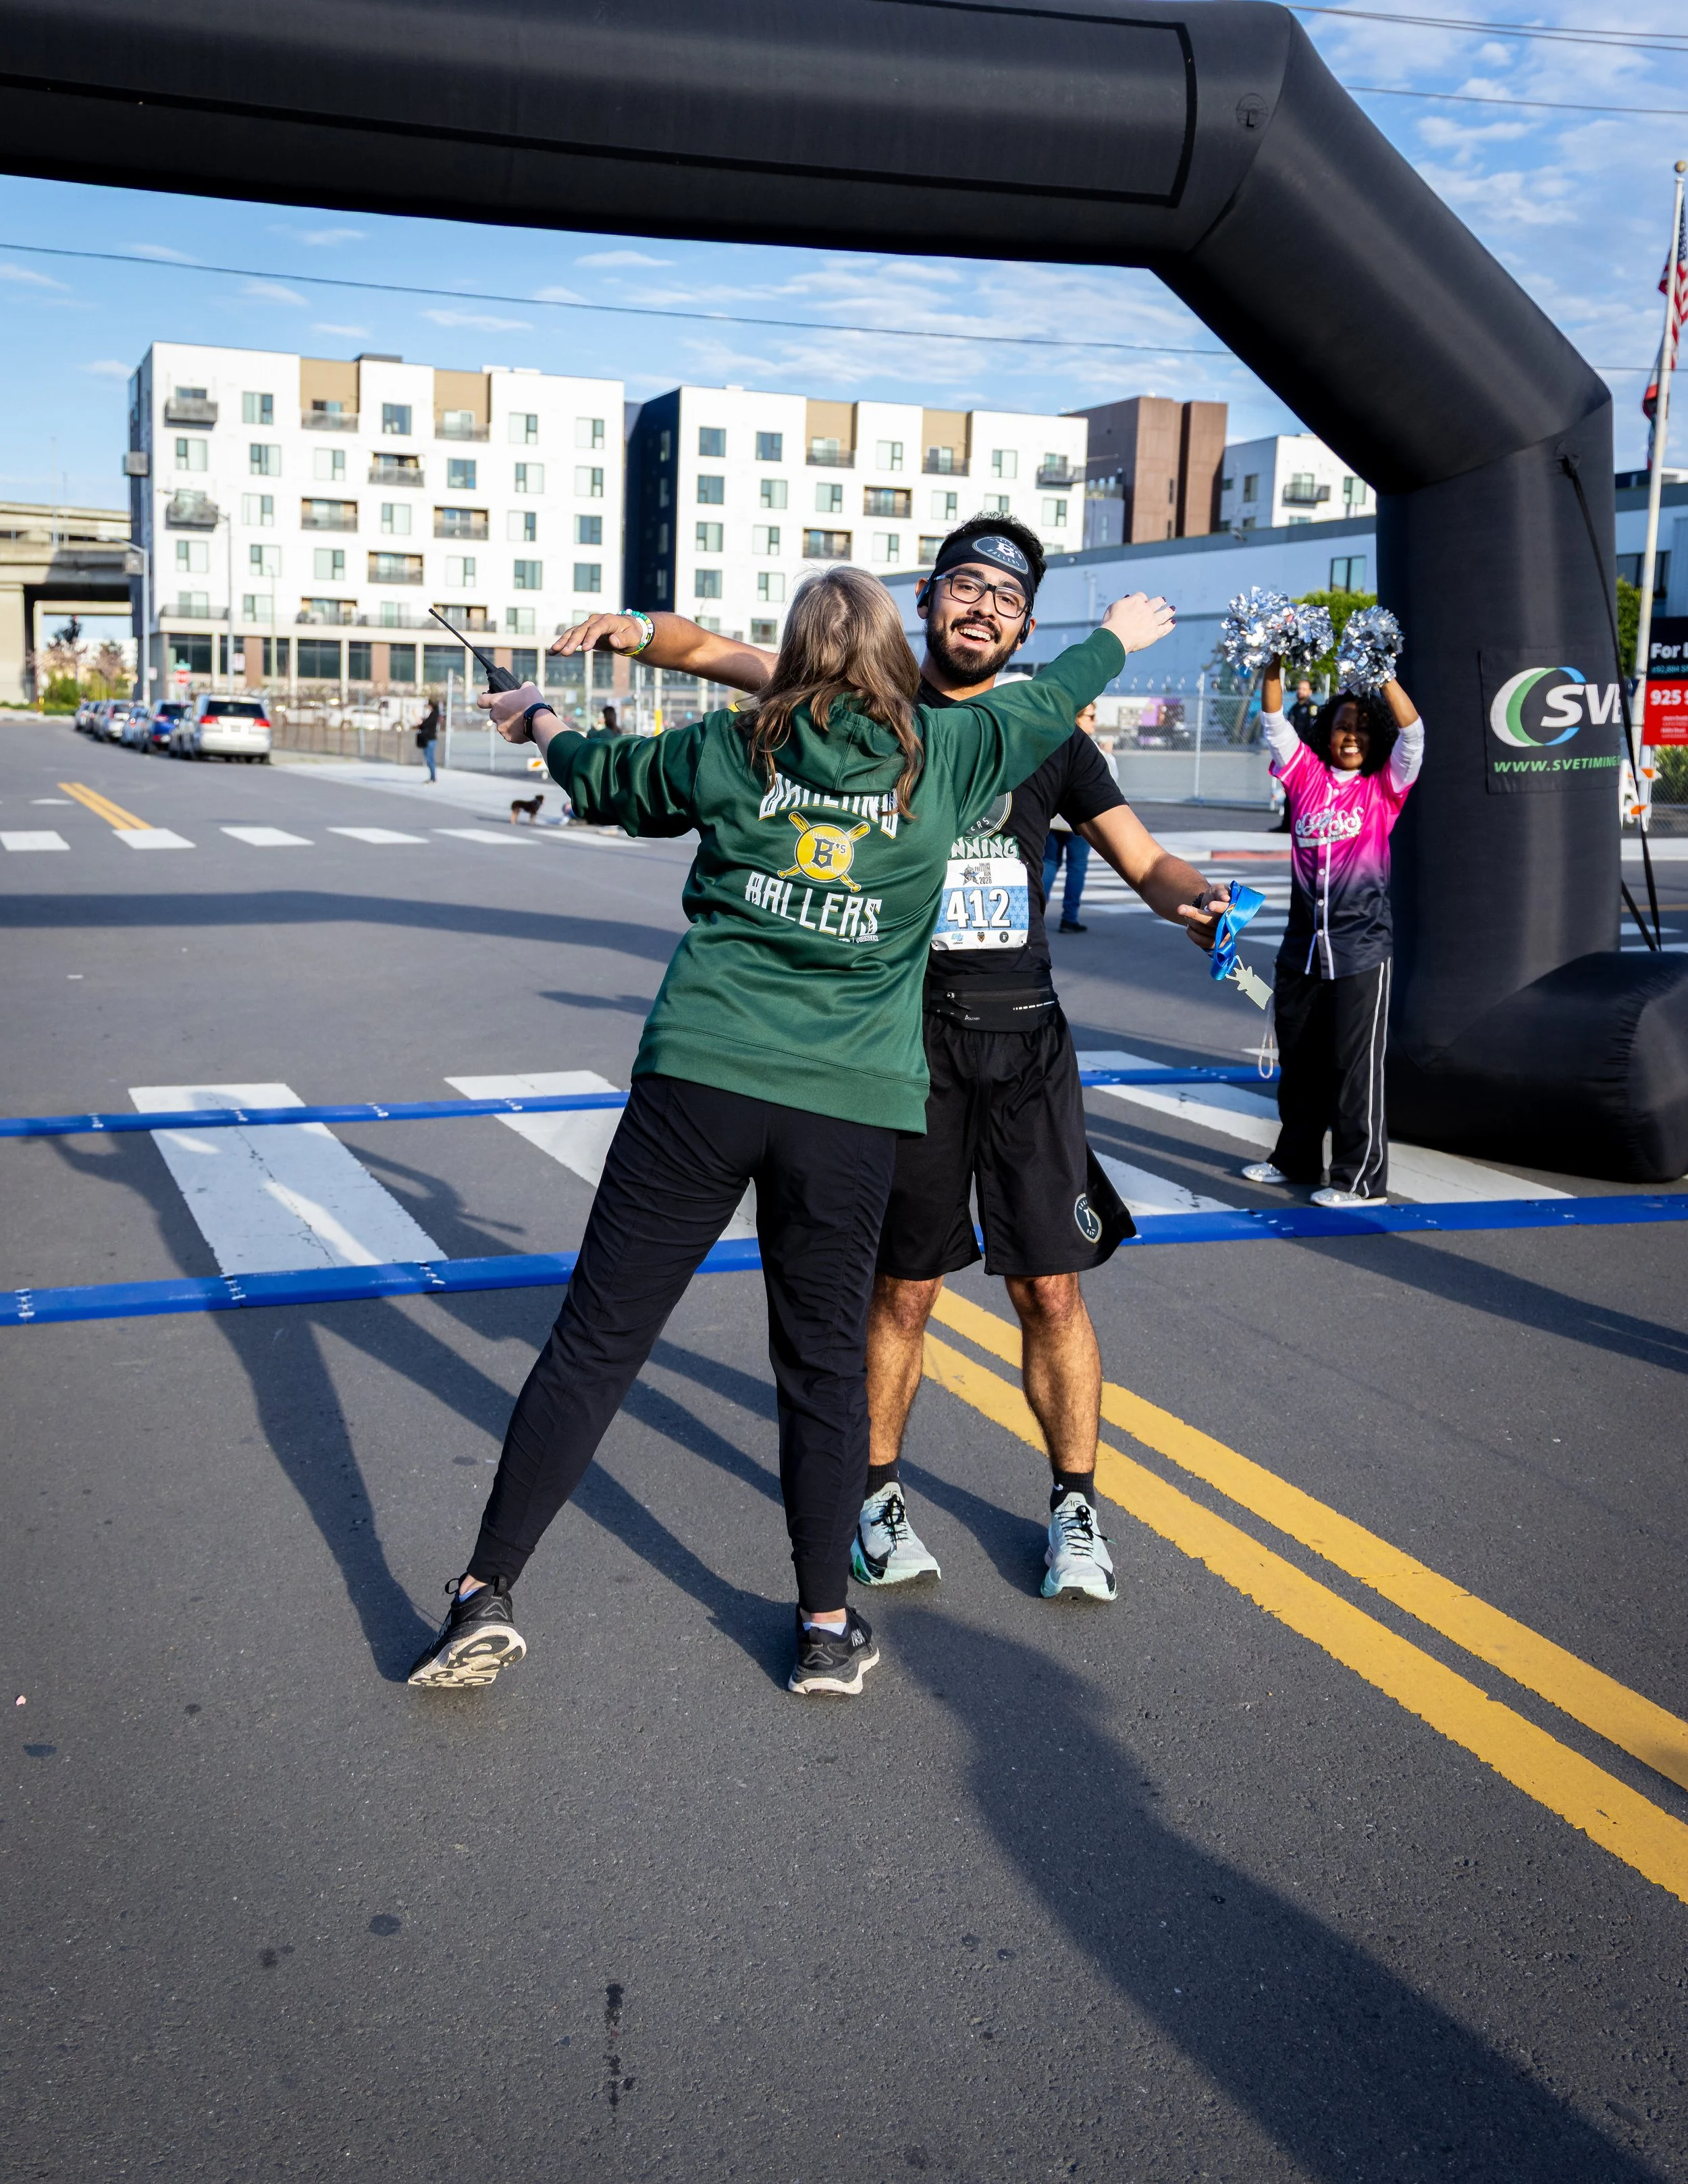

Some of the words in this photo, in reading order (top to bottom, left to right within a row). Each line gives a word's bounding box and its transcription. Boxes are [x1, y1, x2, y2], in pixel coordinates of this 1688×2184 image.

[1650, 642, 1681, 660] For
[1650, 689, 1682, 706] 925
[810, 837, 847, 869] B's
[979, 876, 993, 884] 2026
[745, 871, 882, 937] BALLERS
[946, 889, 1011, 929] 412
[855, 935, 879, 943] PIONEER
